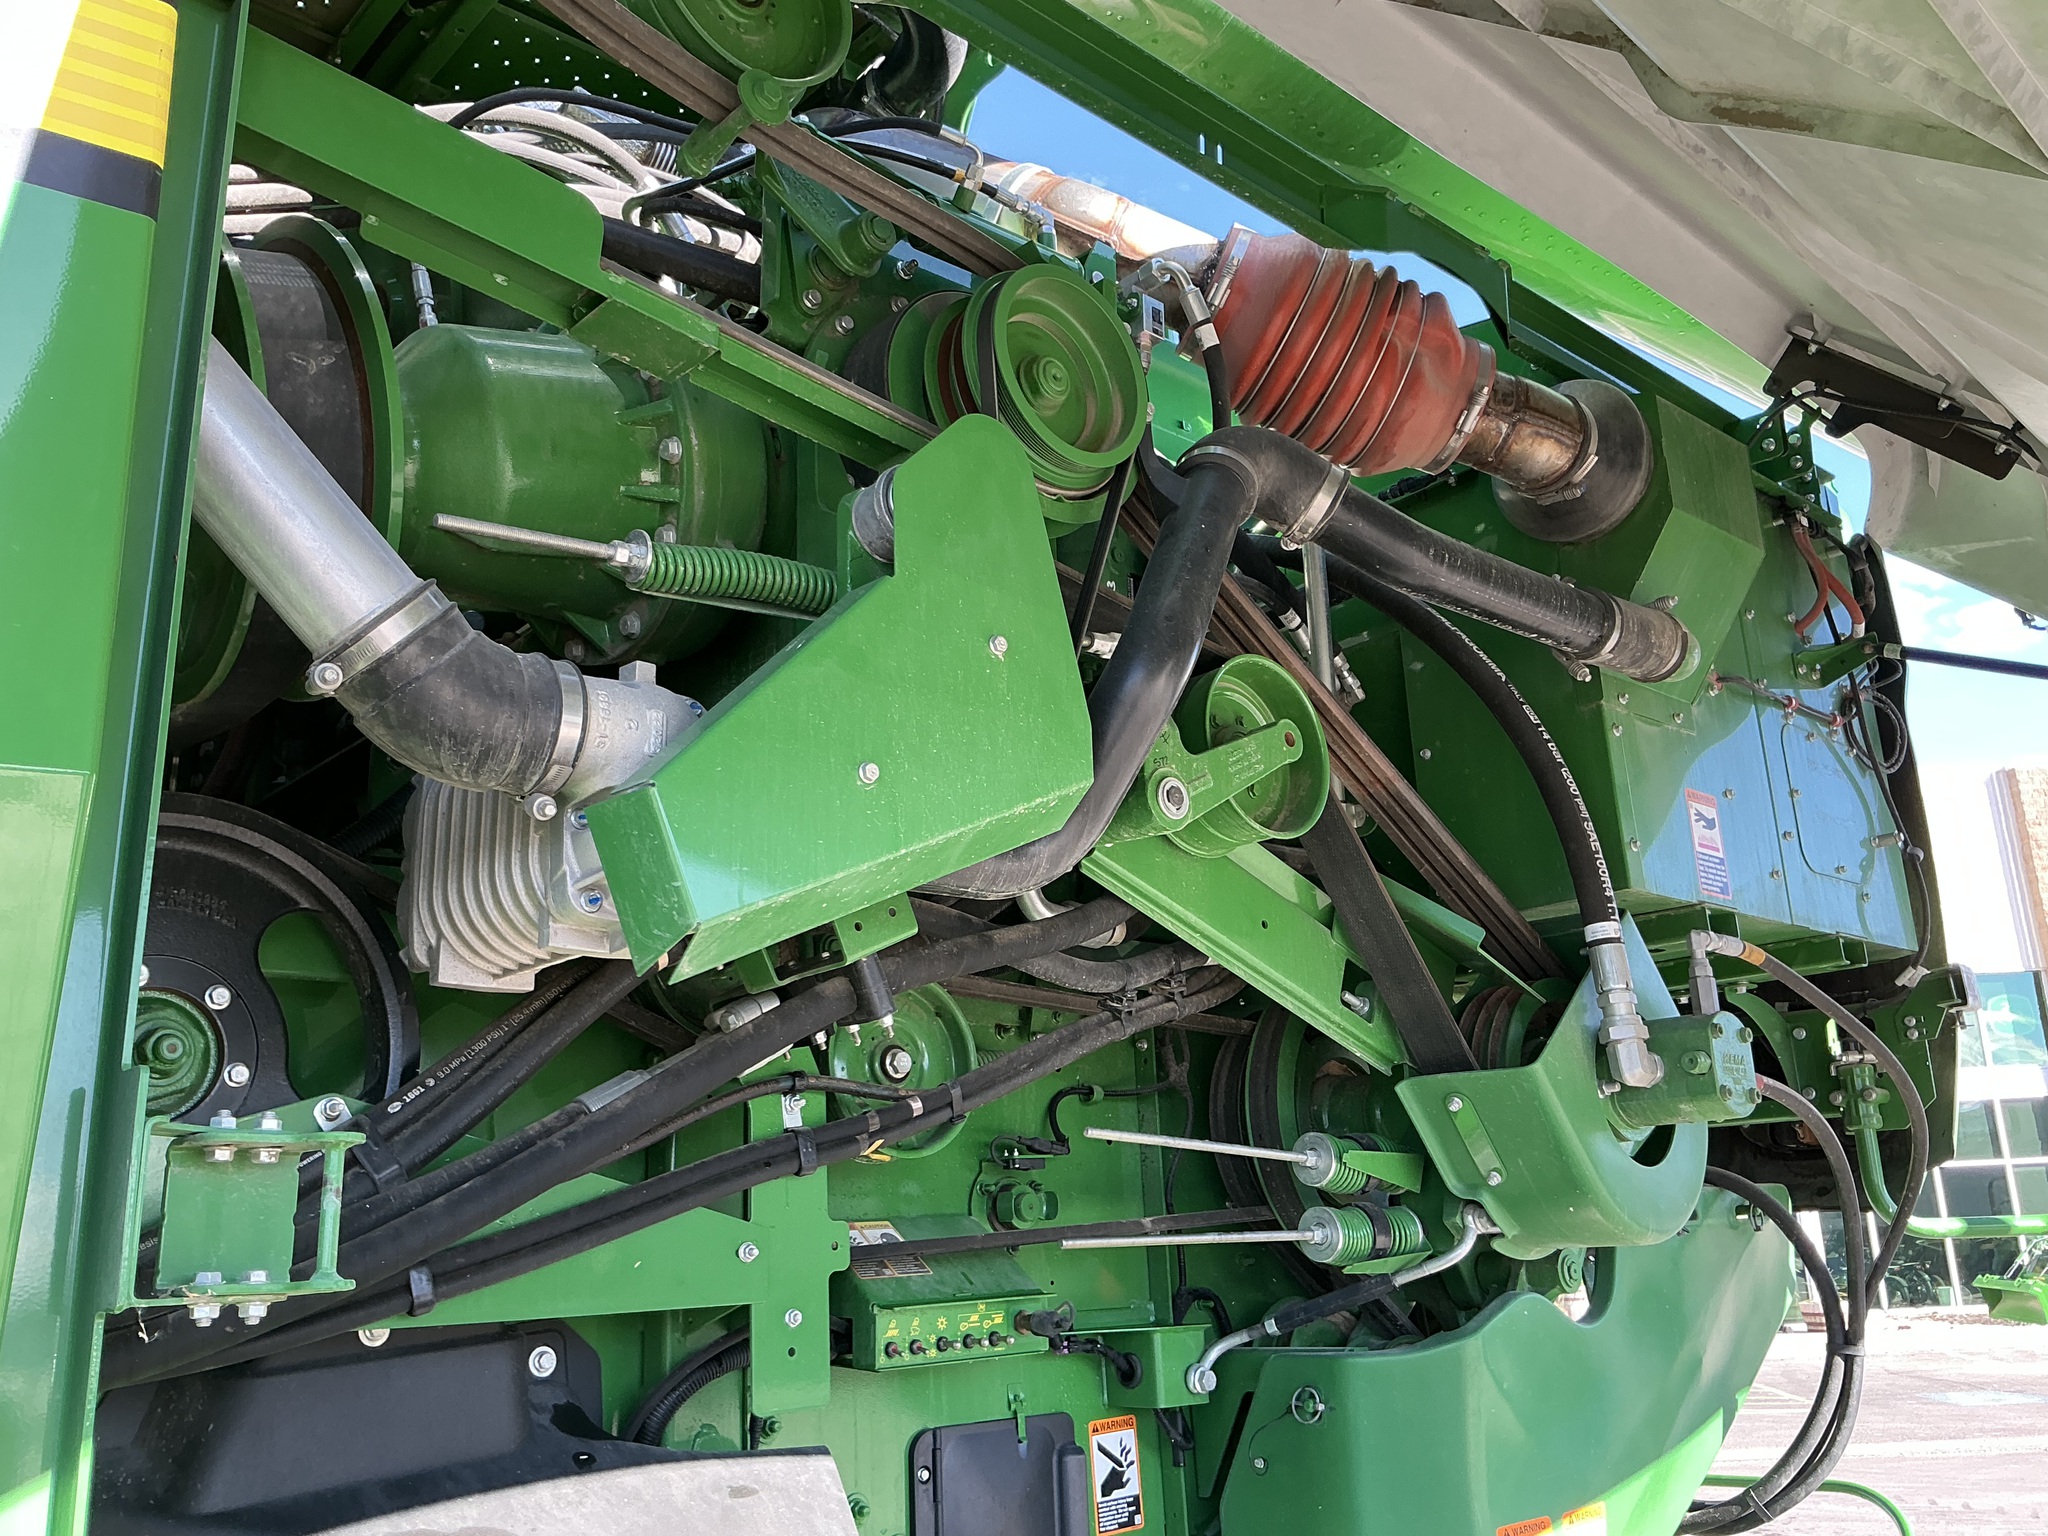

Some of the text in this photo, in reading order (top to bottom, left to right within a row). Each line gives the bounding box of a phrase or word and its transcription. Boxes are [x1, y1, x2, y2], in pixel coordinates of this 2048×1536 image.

[1508, 684, 1526, 703] ITALY
[1547, 742, 1566, 765] bar
[1561, 767, 1580, 795] (200
[1584, 821, 1614, 898] SAE100R4
[436, 1066, 450, 1080] 9.0
[448, 1055, 467, 1073] MPa
[1099, 1417, 1135, 1432] WARNING
[1511, 1520, 1547, 1536] WARNING
